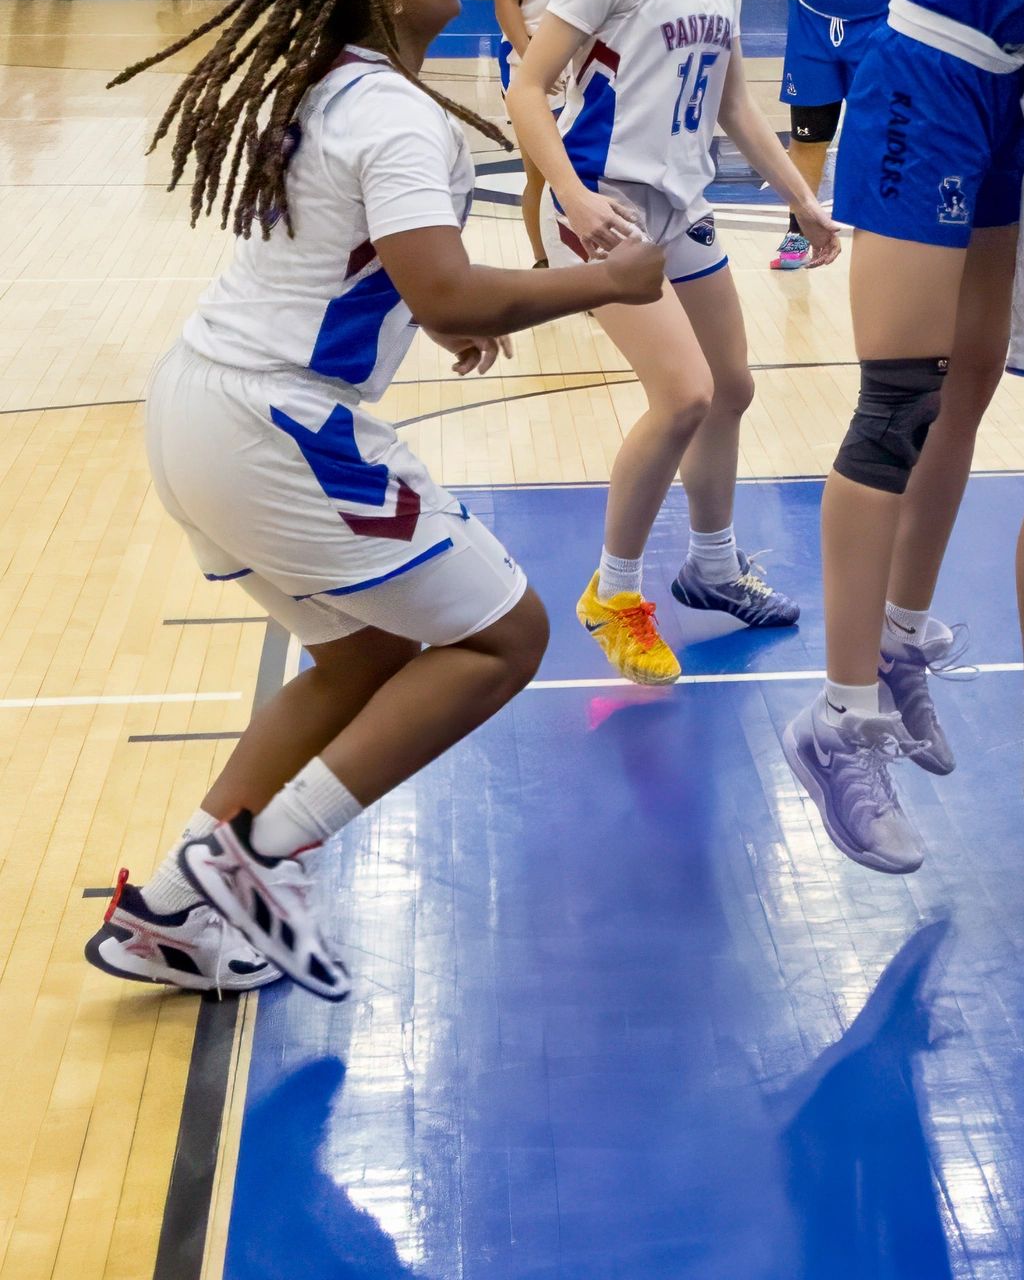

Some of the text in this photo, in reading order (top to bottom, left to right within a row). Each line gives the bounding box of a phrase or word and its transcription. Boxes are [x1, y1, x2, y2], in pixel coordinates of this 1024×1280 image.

[660, 13, 732, 52] PANTHER
[671, 52, 720, 136] 15
[880, 91, 913, 199] RAIDERS
